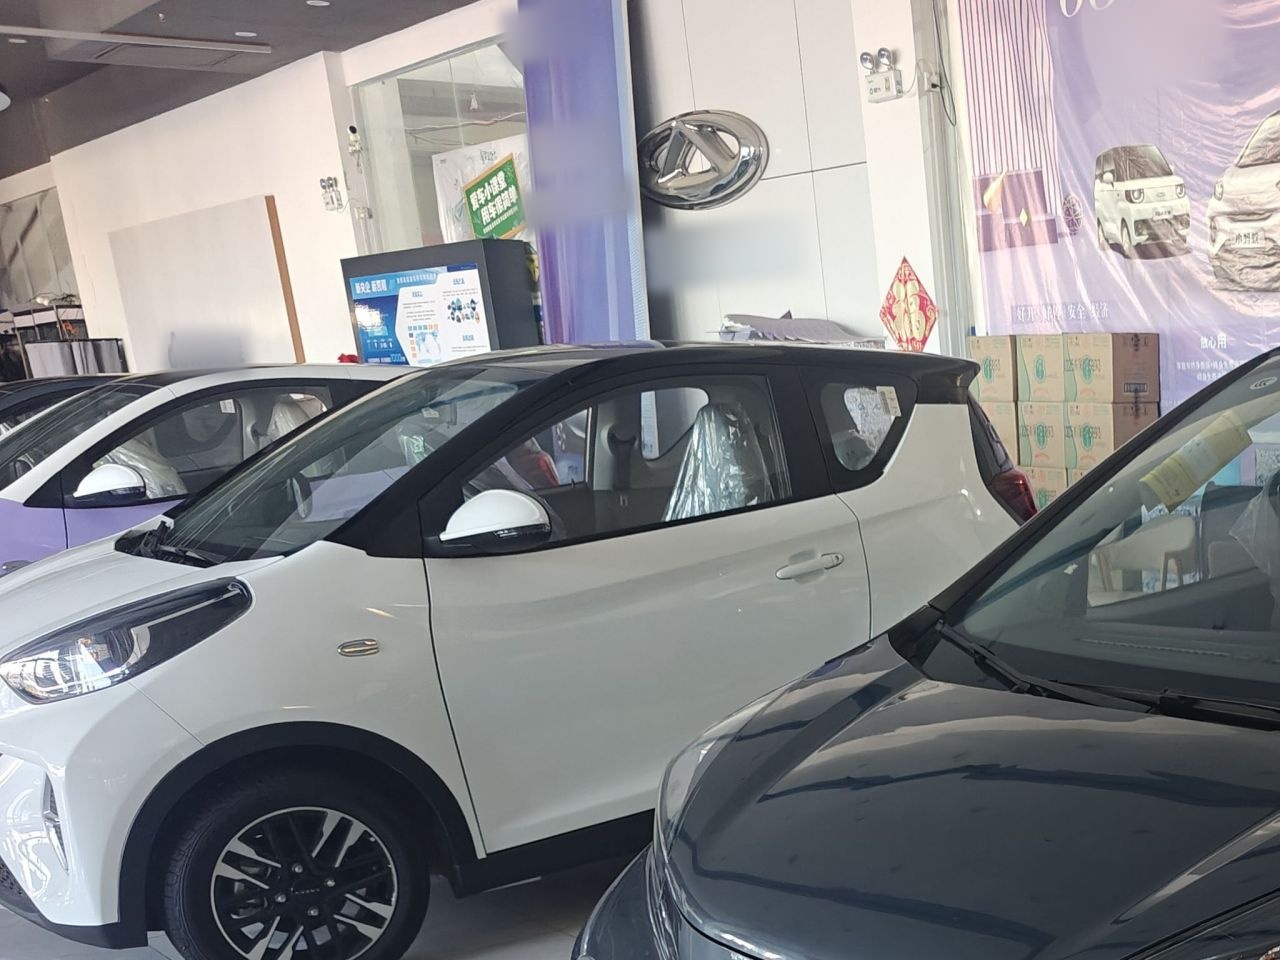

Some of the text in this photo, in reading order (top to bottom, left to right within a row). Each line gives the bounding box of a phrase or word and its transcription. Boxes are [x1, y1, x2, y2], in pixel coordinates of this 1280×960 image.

[1016, 305, 1036, 322] 好开
[1067, 304, 1086, 321] 安全
[1199, 334, 1228, 350] 放心用
